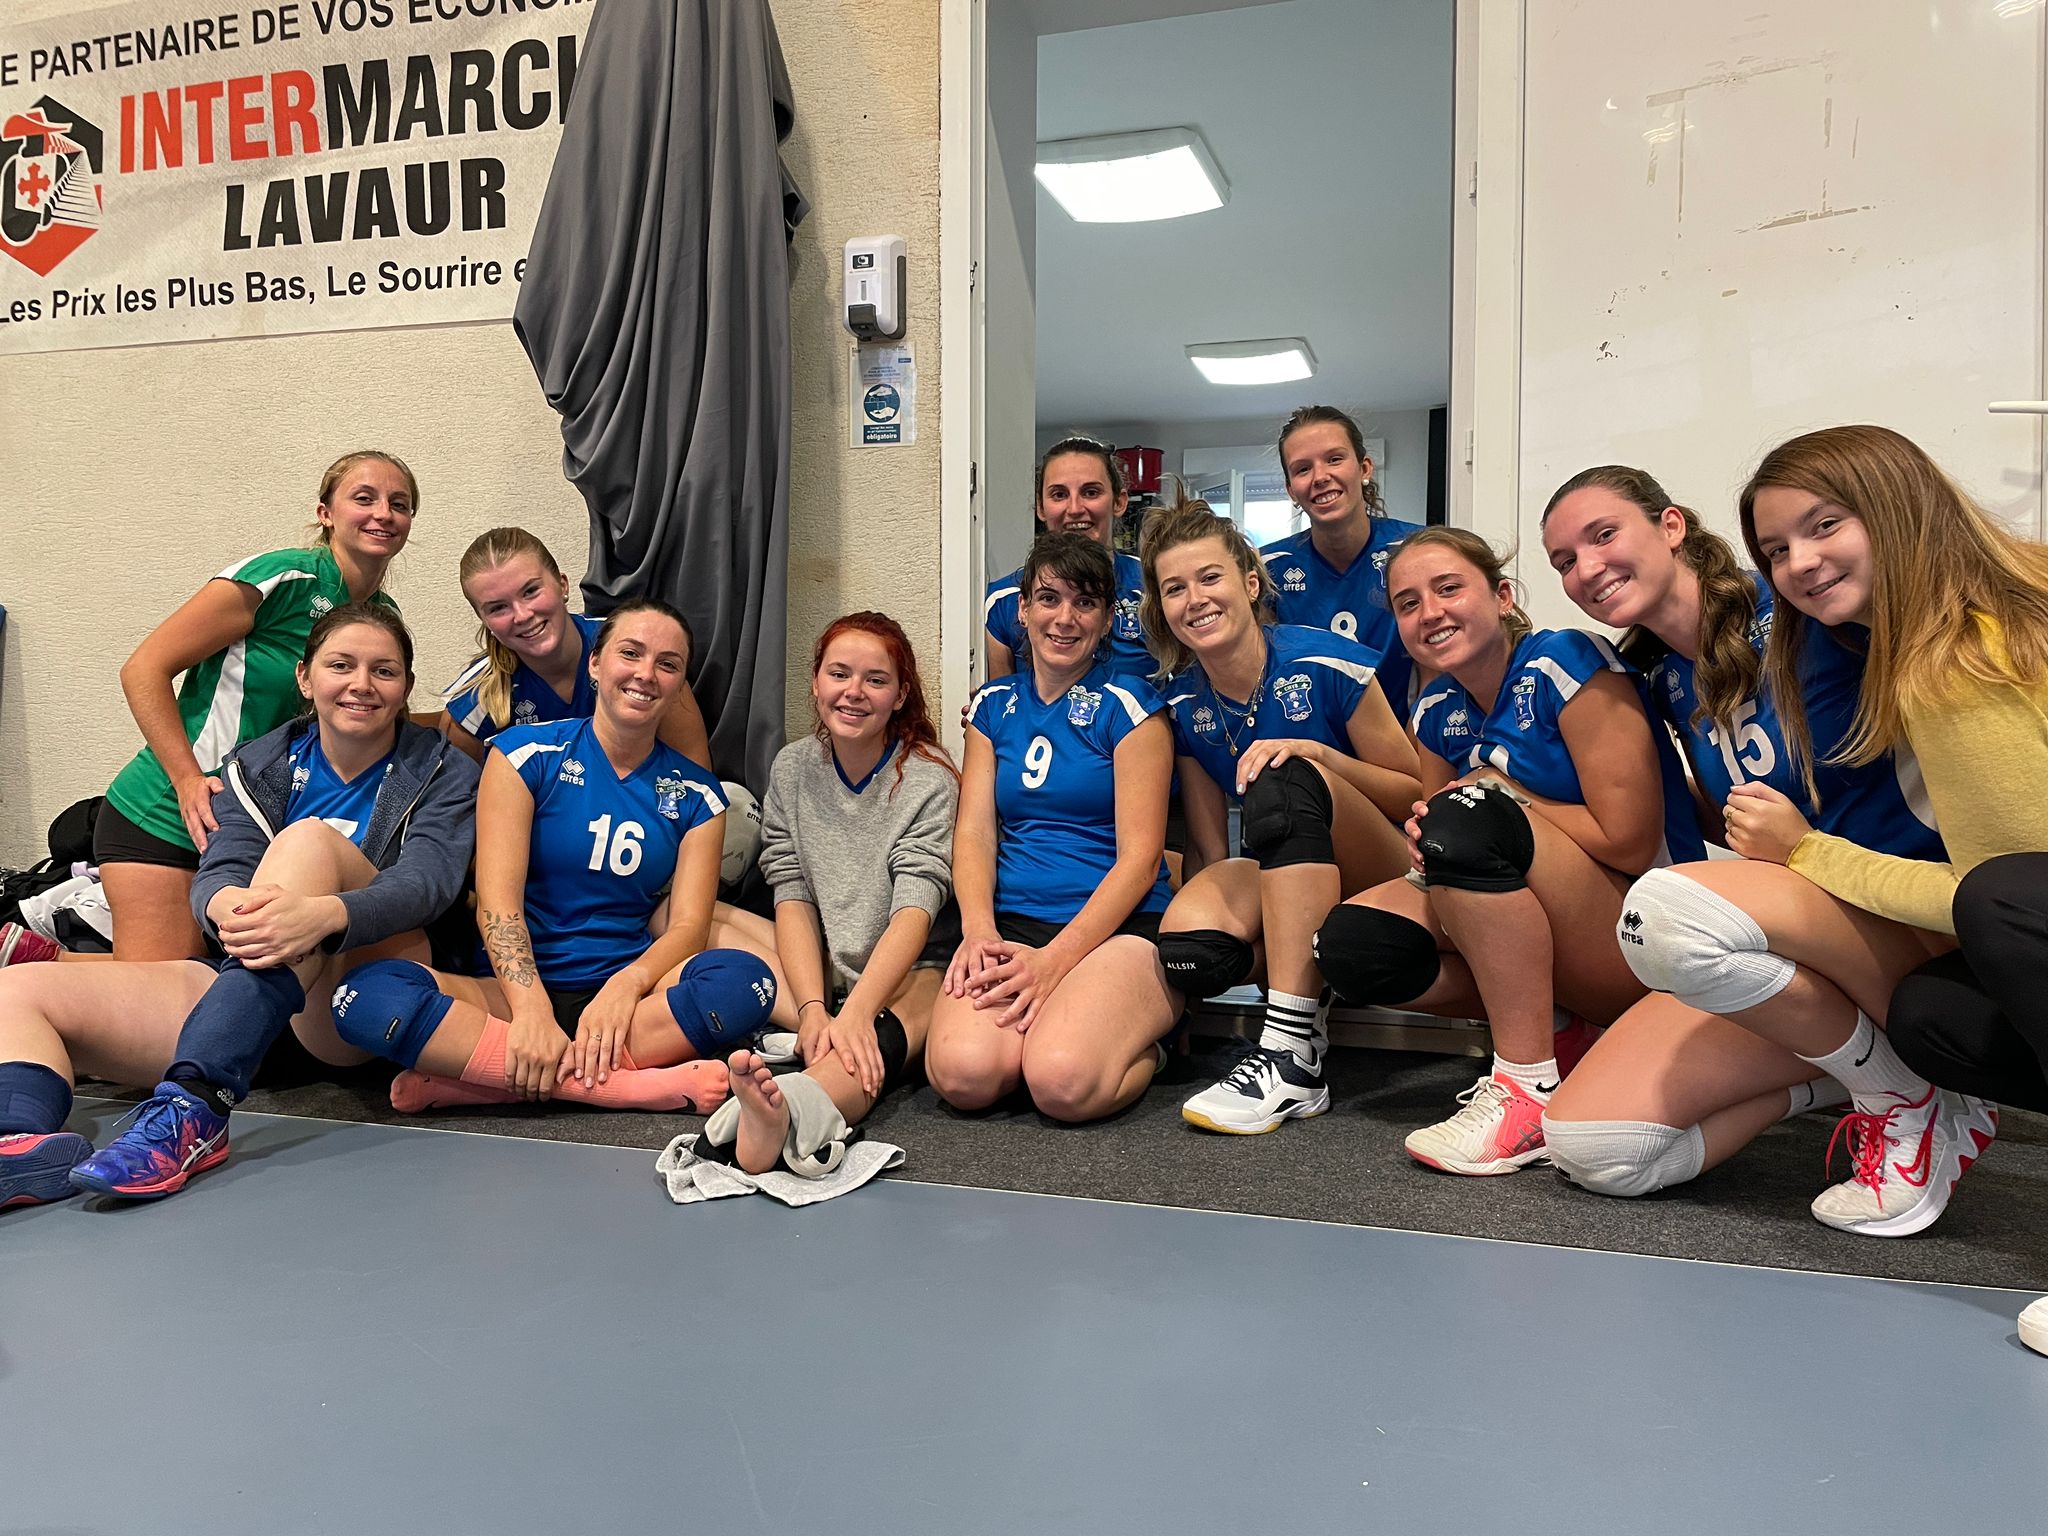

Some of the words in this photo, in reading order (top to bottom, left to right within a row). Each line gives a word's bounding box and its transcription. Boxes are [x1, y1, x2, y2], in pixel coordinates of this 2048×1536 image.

[31, 14, 240, 82] PARTENAIRE
[252, 4, 301, 44] DE
[312, 0, 394, 35] VOS
[223, 157, 506, 251] LAVAUR
[52, 288, 106, 319] Prix
[116, 284, 157, 313] les
[168, 277, 234, 308] Plus
[245, 271, 315, 304] Bas,
[327, 265, 367, 297] Le
[378, 255, 502, 294] Sourire
[866, 433, 898, 441] obligatoire
[1283, 582, 1306, 592] errea
[1193, 721, 1217, 733] errea
[1443, 726, 1469, 737] errea
[1708, 699, 1776, 786] 15
[1022, 735, 1053, 789] 9
[560, 772, 585, 786] errea
[1448, 792, 1476, 809] errea
[588, 813, 645, 877] 16
[1167, 961, 1197, 970] ALLSIX
[338, 989, 359, 1018] errea
[751, 982, 768, 1008] errea
